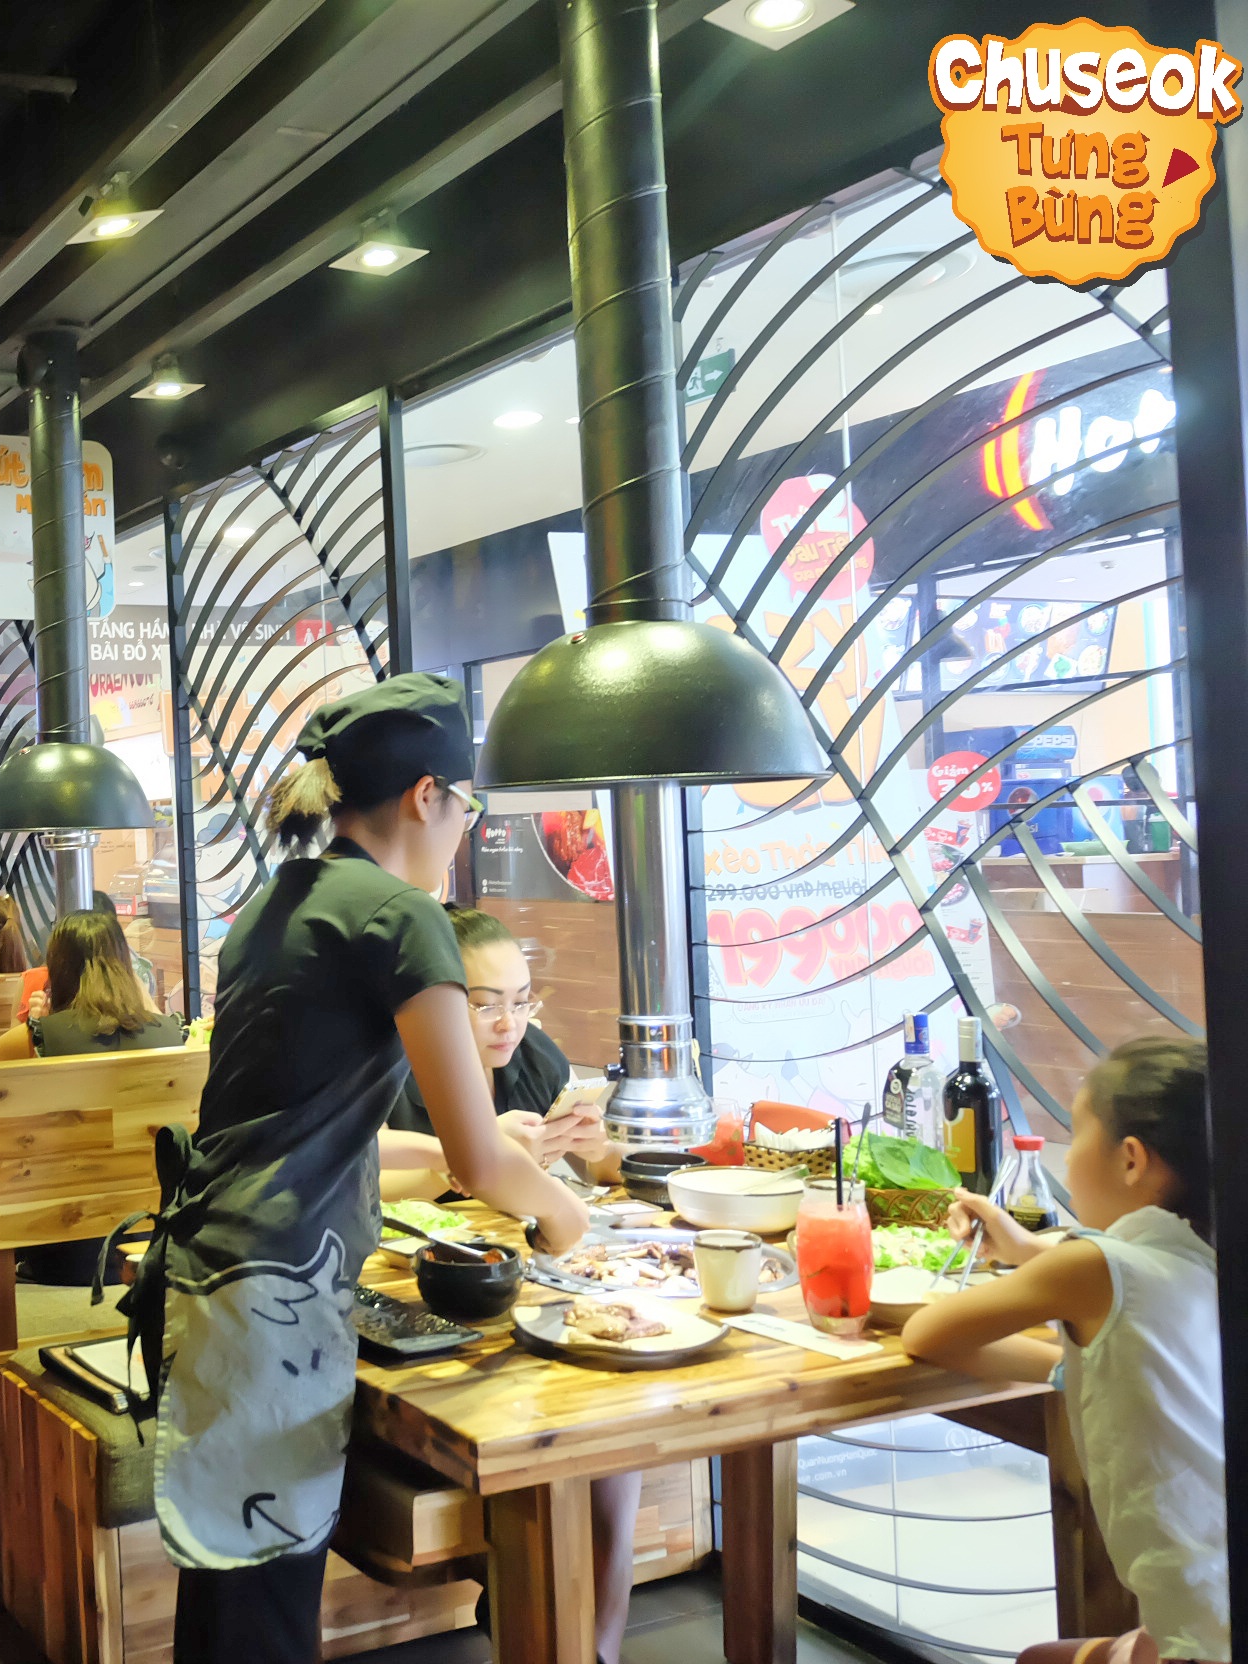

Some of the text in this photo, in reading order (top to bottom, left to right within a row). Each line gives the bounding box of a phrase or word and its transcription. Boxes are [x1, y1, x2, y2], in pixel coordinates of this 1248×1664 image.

[89, 617, 135, 639] TẦNG
[90, 640, 119, 661] BÃI
[123, 638, 147, 661] ĐỖ
[1035, 734, 1075, 747] PEPSI
